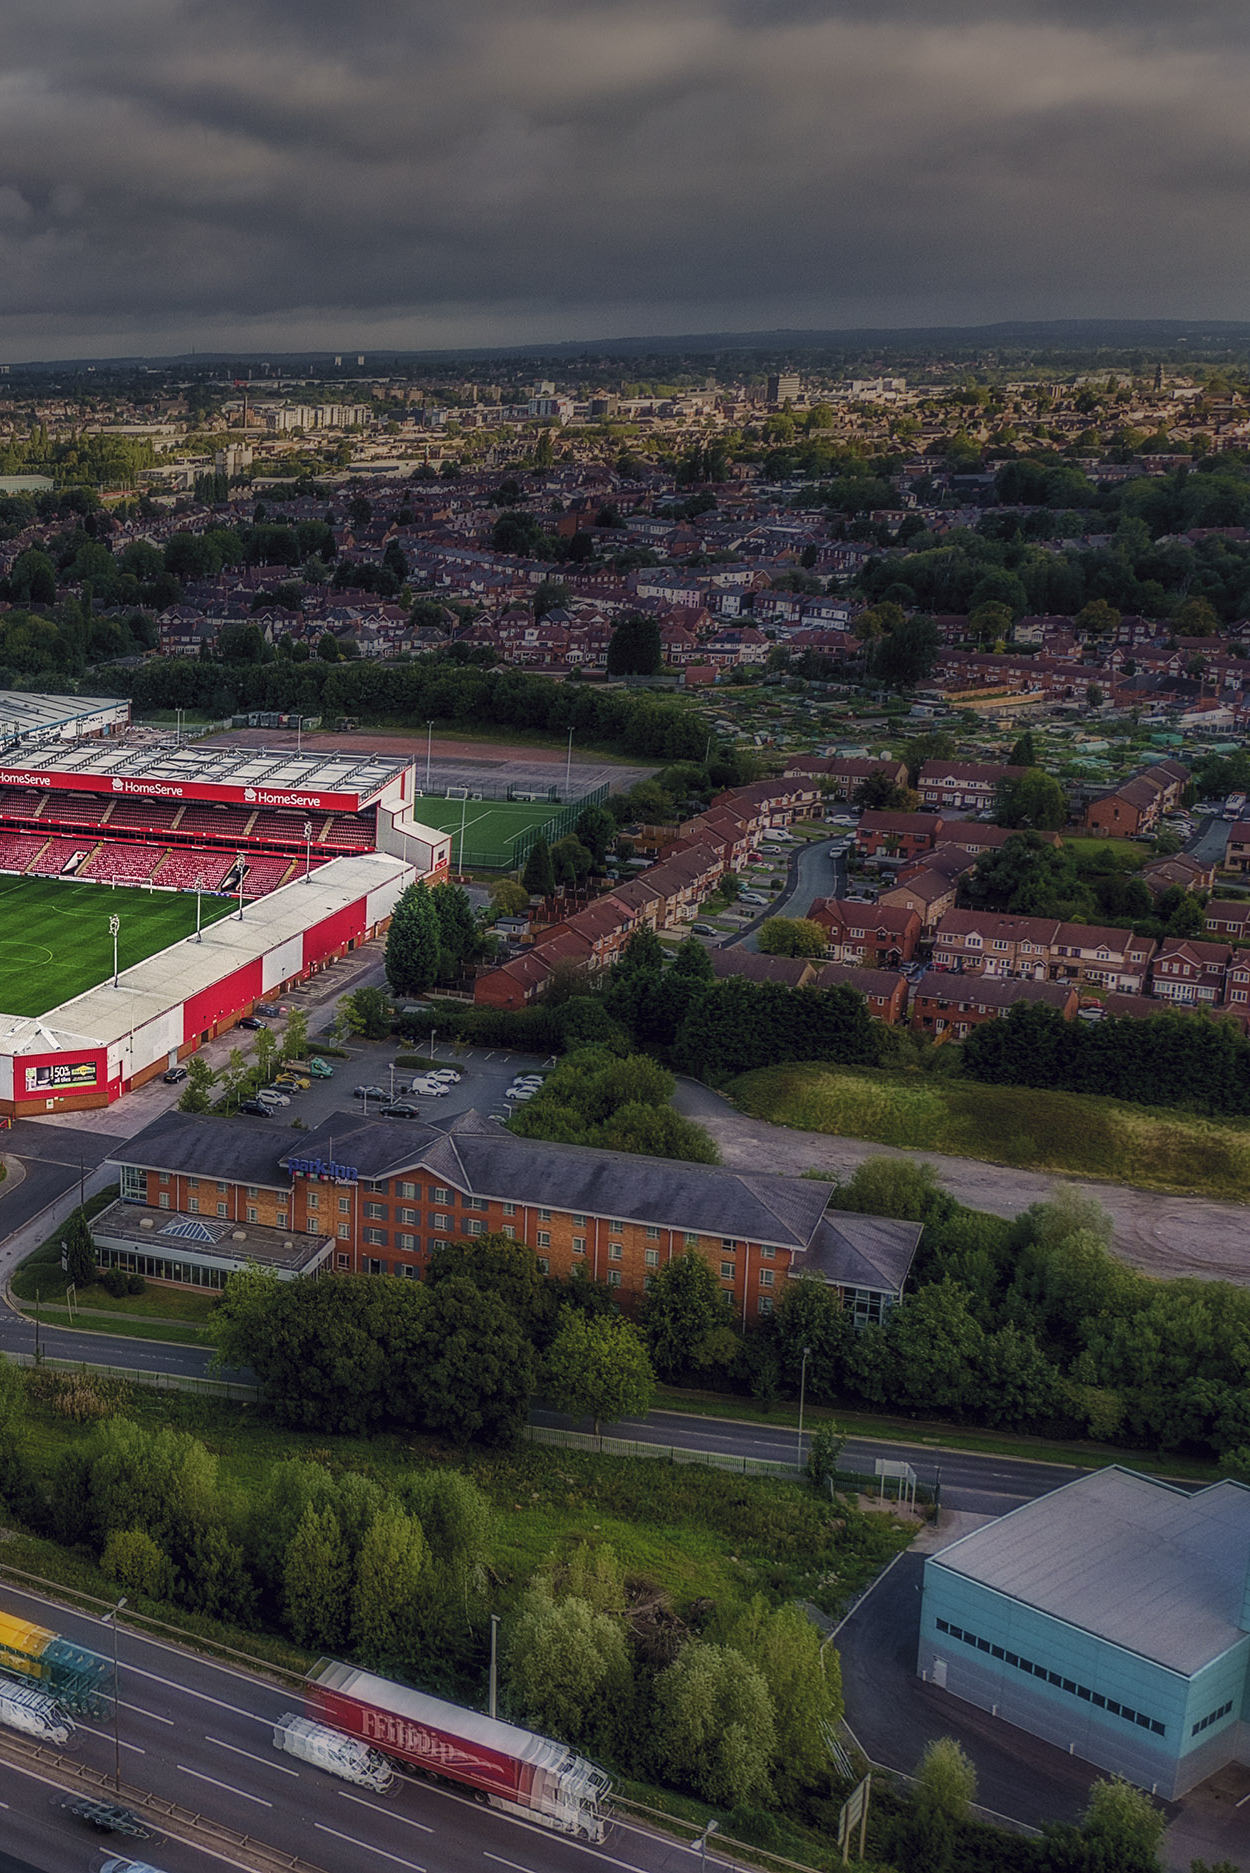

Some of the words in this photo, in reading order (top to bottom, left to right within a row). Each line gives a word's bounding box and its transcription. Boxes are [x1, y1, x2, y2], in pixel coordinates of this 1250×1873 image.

[125, 781, 183, 796] HomeServe
[258, 791, 320, 806] HomeServe
[54, 1066, 70, 1077] 50%
[288, 1158, 327, 1175] park
[330, 1161, 358, 1180] inn
